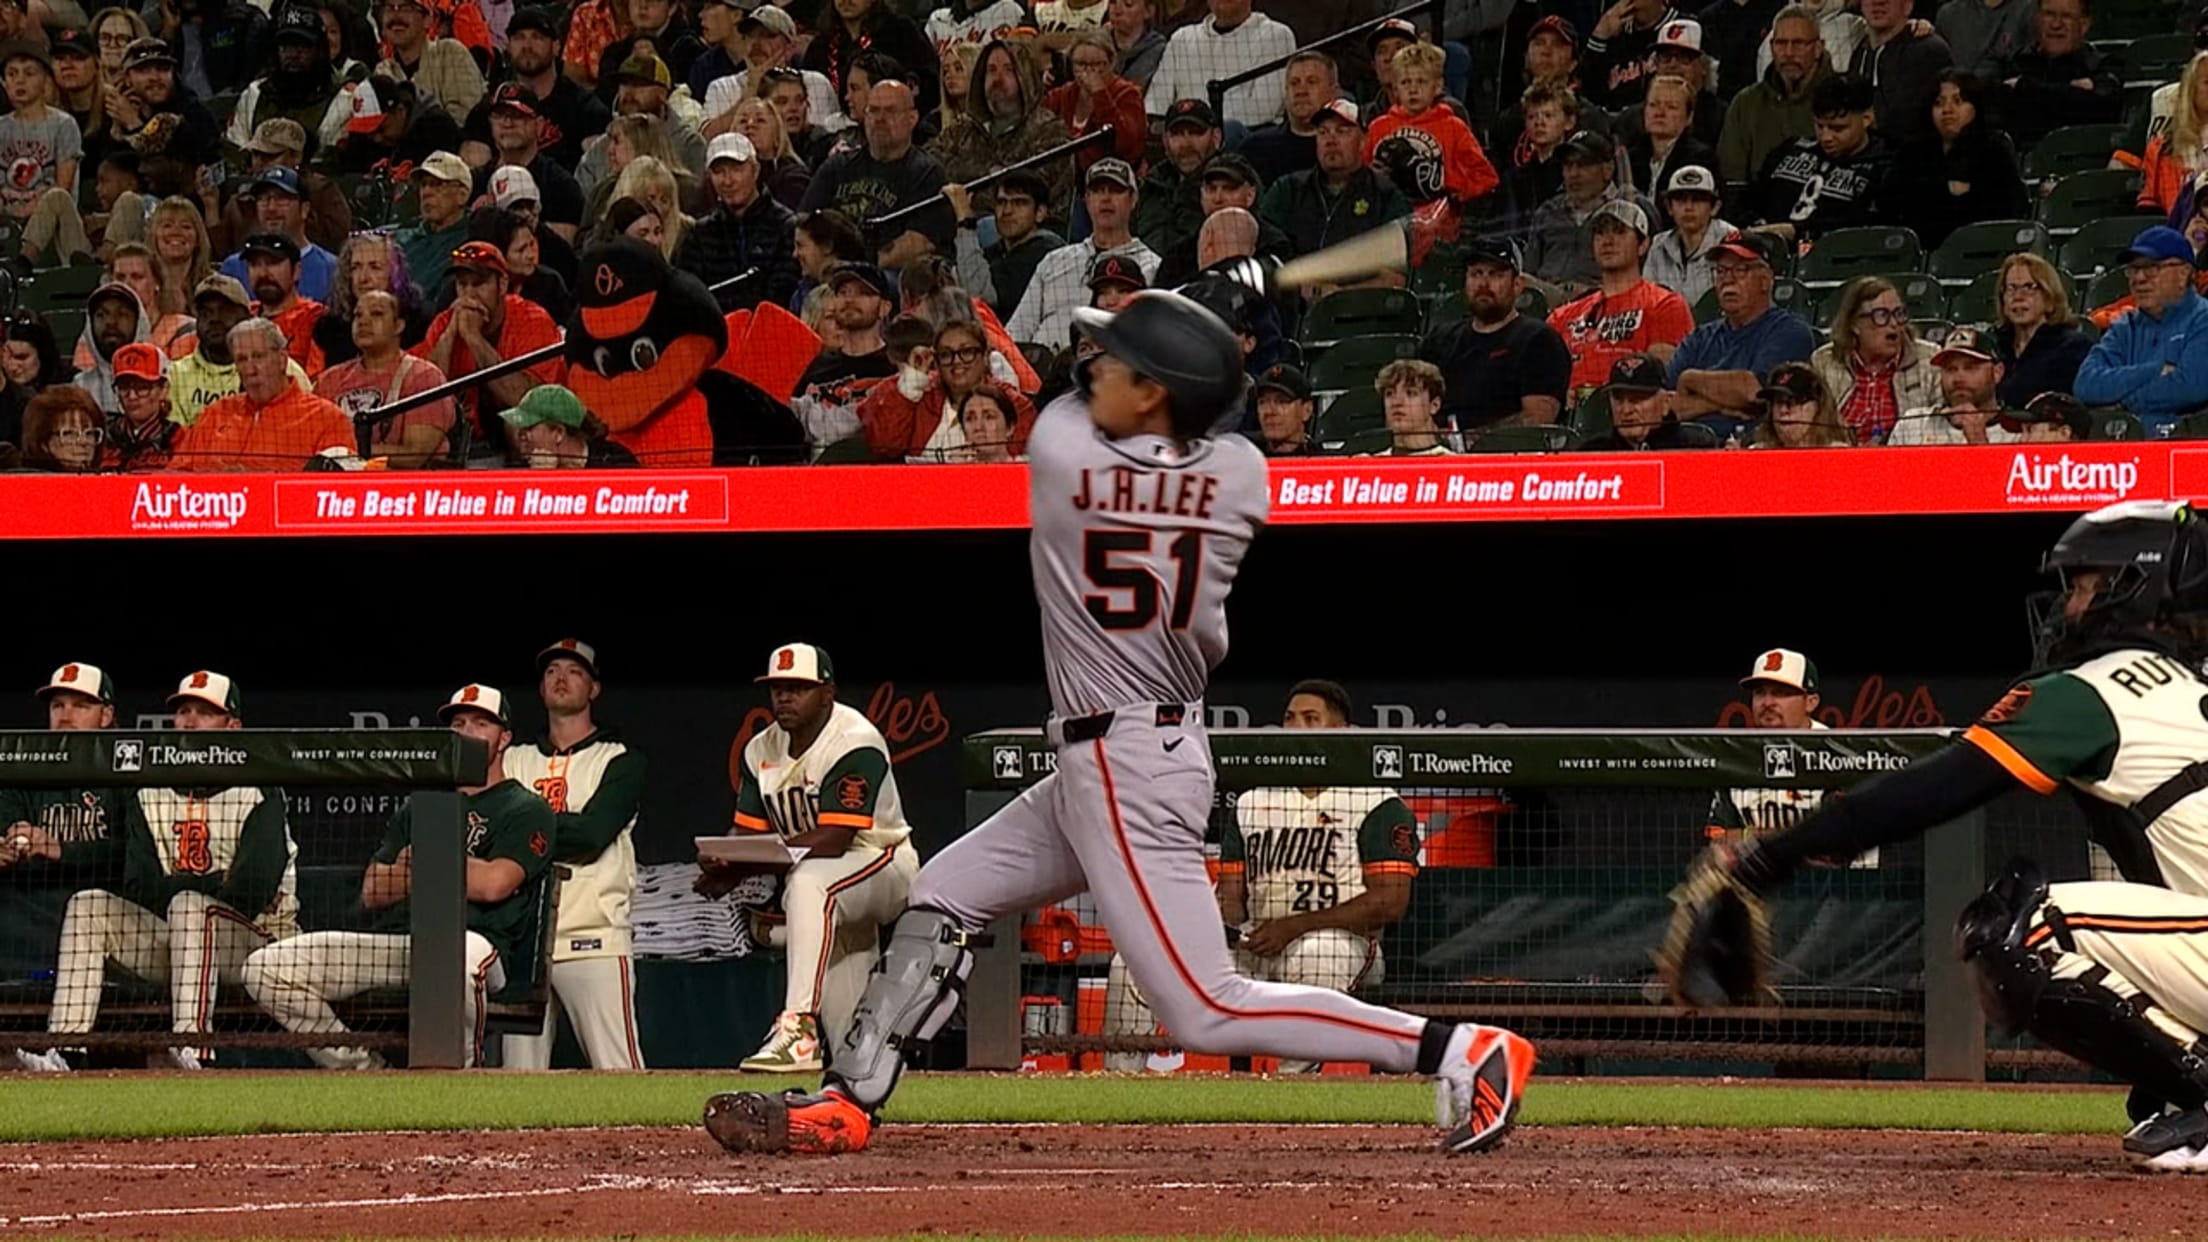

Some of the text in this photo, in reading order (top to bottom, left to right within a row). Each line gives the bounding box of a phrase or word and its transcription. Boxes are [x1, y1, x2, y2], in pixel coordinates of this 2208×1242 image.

[1789, 174, 1824, 220] 8
[1279, 472, 1623, 505] Best Value in Home Comfort
[2006, 453, 2140, 498] Airtemp
[131, 482, 248, 526] Airtemp
[316, 486, 689, 518] The Best Value in Home Comfort
[1083, 529, 1202, 632] 51
[2109, 653, 2189, 698] RUT
[0, 751, 70, 762] CONFIDENCE
[291, 750, 437, 761] INVEST WITH CONFIDENCE
[1220, 755, 1327, 766] WITH CONFIDENCE
[1559, 758, 1717, 769] INVEST WITH CONFIDENCE
[1246, 826, 1342, 883] BMORE
[1292, 880, 1339, 911] 29
